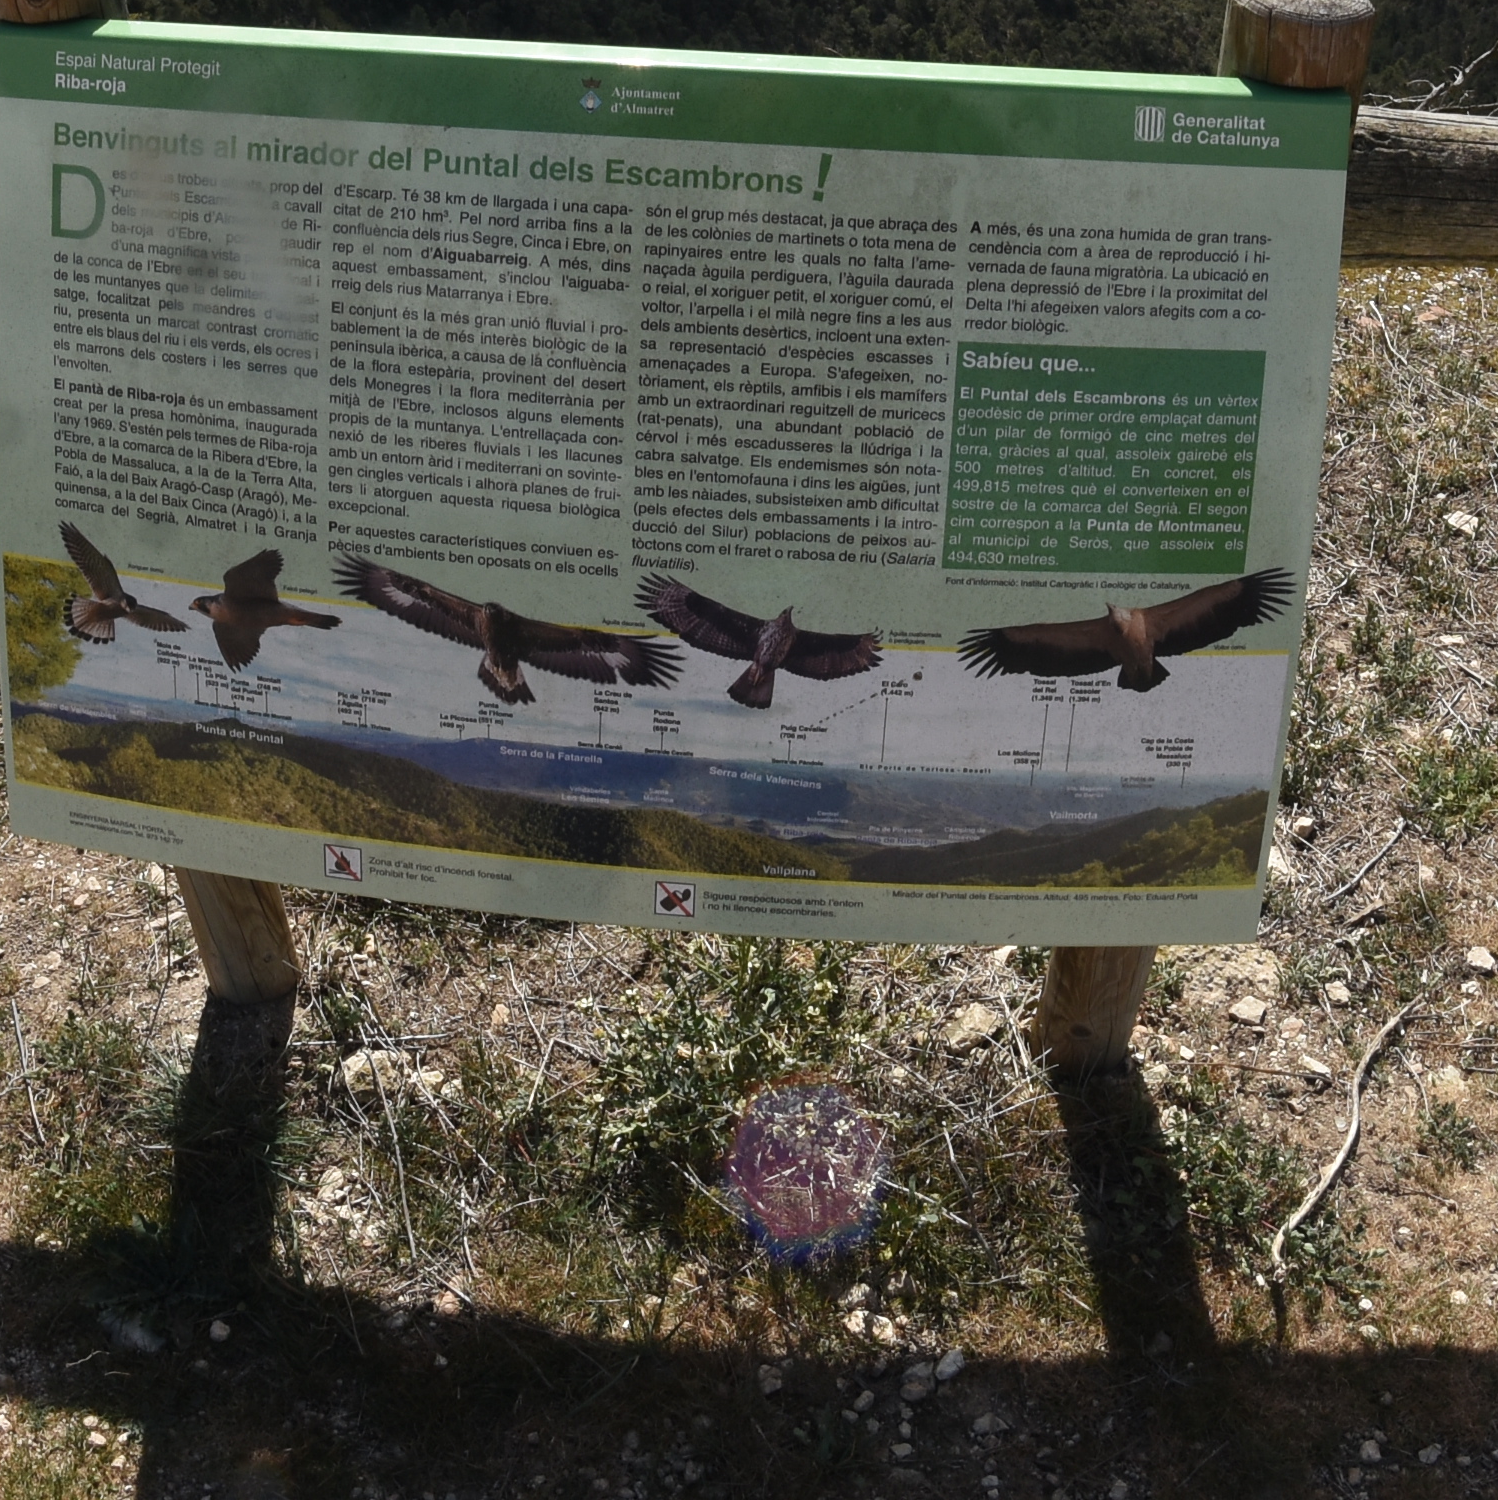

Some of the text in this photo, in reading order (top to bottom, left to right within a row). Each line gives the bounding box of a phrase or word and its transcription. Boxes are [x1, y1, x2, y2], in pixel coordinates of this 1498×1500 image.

[55, 51, 221, 78] Espai Natural Protegit
[55, 73, 126, 95] Riba-roja
[611, 86, 681, 100] Ajuntament
[610, 102, 674, 116] d'Almatret
[1173, 112, 1266, 130] Generalitat
[1172, 130, 1280, 150] de Catalunya
[214, 134, 237, 159] al
[246, 138, 359, 168] mirador
[368, 143, 412, 172] del
[423, 147, 519, 178] Puntal
[529, 152, 594, 183] dels
[333, 183, 396, 203] d'Escarp.
[404, 187, 419, 202] Té
[423, 188, 440, 203] 38
[445, 190, 465, 205] km
[470, 191, 488, 206] de
[493, 193, 548, 212] llargada
[562, 202, 588, 212] una
[592, 203, 633, 218] capa-
[333, 201, 361, 216] citat
[366, 203, 383, 217] de
[390, 204, 416, 220] 210
[459, 209, 481, 224] Pel
[488, 213, 519, 227] nord
[525, 215, 566, 230] arriba
[573, 217, 597, 232] fins
[604, 224, 613, 233] a
[620, 220, 632, 235] la
[645, 203, 957, 234] són el grup més destacat, ja que abraça des
[969, 220, 1271, 246] A més, és una zona humida de gran trans-
[964, 315, 1068, 335] rredor biològic.
[1039, 358, 1095, 375] que...
[53, 375, 317, 420] El pantà de Riba-roja és un embassament
[637, 392, 945, 421] amb un extraordinari reguitzell de muricecs
[960, 385, 1258, 407] El Puntal dels Escambrons és un vèrtex
[954, 459, 981, 473] 500
[995, 461, 1043, 475] metres
[1058, 461, 1115, 476] d'altitud.
[1131, 463, 1149, 477] En
[1231, 466, 1251, 480] els
[328, 519, 618, 560] Per aquestes característiques conviuen es-
[631, 555, 700, 572] fluviatilis).
[947, 547, 1058, 565] 494,630 metres.
[195, 723, 284, 745] Punta del Puntal
[500, 745, 602, 764] Serra de la Fatarella
[709, 765, 822, 789] Serra dels Valencians
[368, 855, 392, 866] Zona
[394, 858, 413, 869] d'alt
[415, 861, 432, 871] risc
[477, 868, 514, 881] forestal.
[368, 864, 436, 883] Prohibit fer foc.
[762, 864, 816, 878] Vallplana
[702, 890, 863, 908] Sigueu respectuosos amb l'entorn
